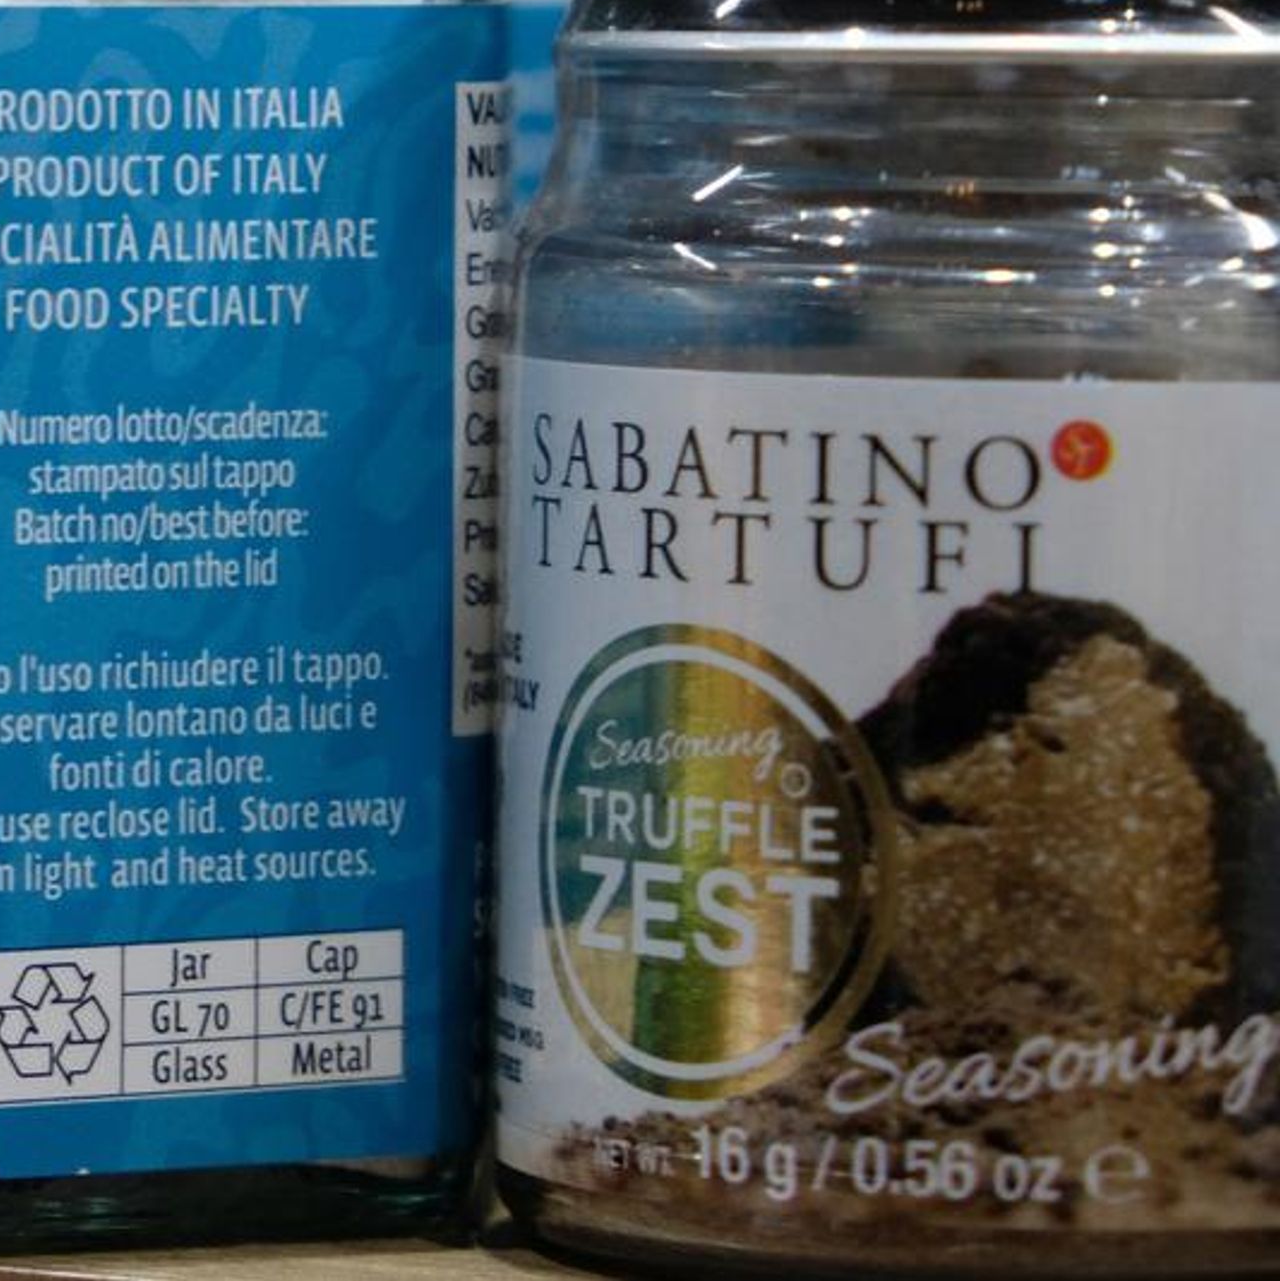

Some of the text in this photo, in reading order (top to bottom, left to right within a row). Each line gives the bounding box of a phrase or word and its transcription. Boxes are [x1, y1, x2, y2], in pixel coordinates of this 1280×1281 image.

[183, 88, 221, 129] IN
[232, 86, 344, 130] ITALIA
[173, 153, 221, 195] OF
[232, 152, 327, 194] ITALY
[147, 217, 379, 264] ALIMENTARE
[6, 284, 309, 332] FOOD SPECIALTY
[116, 401, 328, 446] lotto/scadenza:
[28, 454, 295, 501] stampato sul tappo
[533, 412, 1043, 511] SABATINO
[14, 500, 310, 545] Batch no/best before:
[533, 496, 1043, 595] TARTUFI
[45, 549, 279, 600] printed on the lid
[19, 658, 93, 694] l'uso
[100, 649, 259, 690] richiudere
[266, 647, 284, 684] il
[292, 648, 389, 689] tappo.
[126, 703, 247, 740] lontano
[255, 698, 292, 734] da
[300, 695, 352, 730] luci
[360, 703, 377, 729] e
[49, 748, 273, 791] fonti di calore.
[589, 719, 784, 780] Seasoning
[60, 802, 169, 839] reclose
[179, 797, 225, 834] lid.
[240, 795, 320, 833] Store
[327, 793, 406, 836] away
[576, 785, 843, 864] TRUFFLE
[24, 852, 97, 900] light
[110, 848, 169, 888] and
[178, 847, 246, 884] heat
[253, 845, 377, 880] sources.
[577, 854, 842, 974] ZEST
[170, 947, 211, 988] Jar
[305, 940, 359, 986] Cap
[152, 1000, 231, 1038] GL 70
[280, 992, 384, 1031] C/FE 91
[152, 1050, 229, 1085] Glass
[291, 1037, 372, 1077] Metal
[825, 1013, 1280, 1115] Seasoning
[692, 1124, 750, 1183] 16
[765, 1139, 798, 1202] g
[851, 1136, 977, 1200] 0.56
[993, 1156, 1063, 1201] oz
